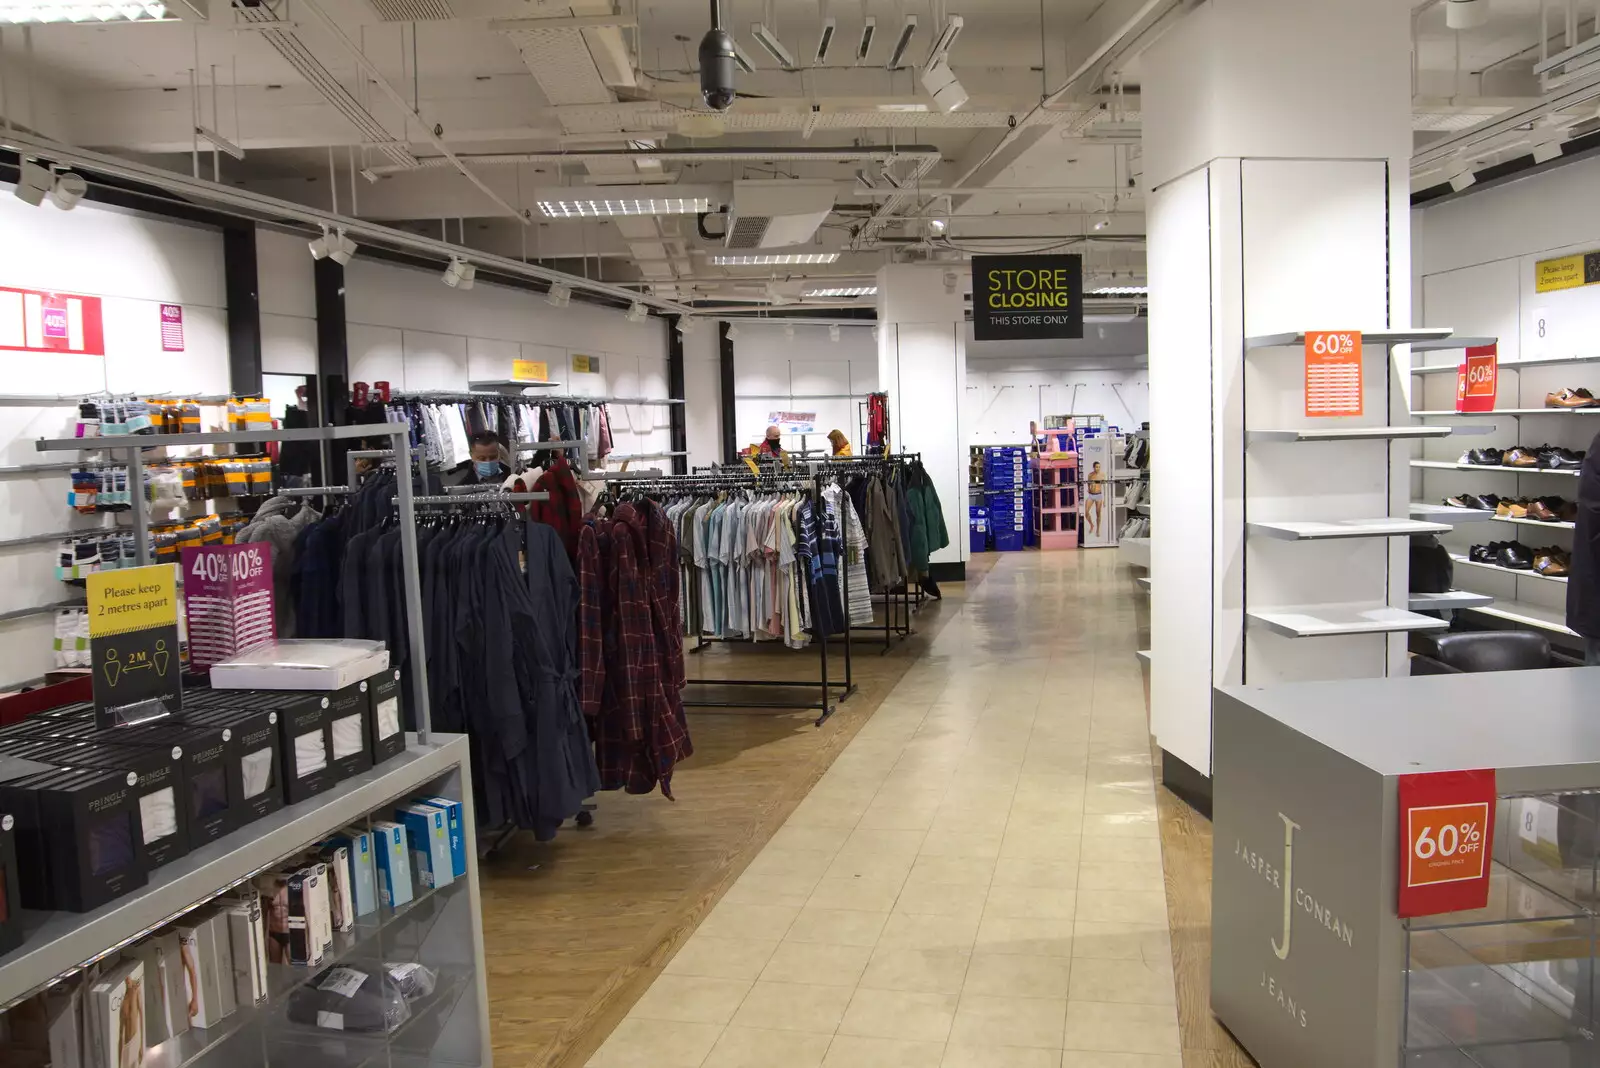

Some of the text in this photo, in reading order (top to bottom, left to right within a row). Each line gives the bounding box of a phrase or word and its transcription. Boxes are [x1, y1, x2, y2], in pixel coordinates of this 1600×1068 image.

[988, 269, 1068, 291] STORE
[1543, 266, 1561, 275] Please
[988, 292, 1068, 308] CLOSING
[990, 315, 1069, 325] THIS STORE ONLY
[1538, 318, 1546, 338] 8
[1312, 334, 1354, 354] 60%
[1469, 364, 1493, 383] 60%
[192, 553, 228, 582] 40%
[232, 548, 262, 582] 40%
[249, 566, 263, 577] OFF
[104, 582, 161, 599] Please keep
[98, 597, 168, 616] 2 metres apart
[128, 651, 146, 664] 2 M
[192, 744, 224, 762] PRINGLE
[137, 766, 171, 784] PRINGLE
[88, 789, 128, 812] PRINGLE
[1414, 822, 1481, 860] 60%
[1458, 842, 1480, 854] OFF
[1234, 838, 1354, 948] JASPER CONRAN
[1271, 811, 1301, 961] J
[1260, 969, 1307, 1028] JEANS
